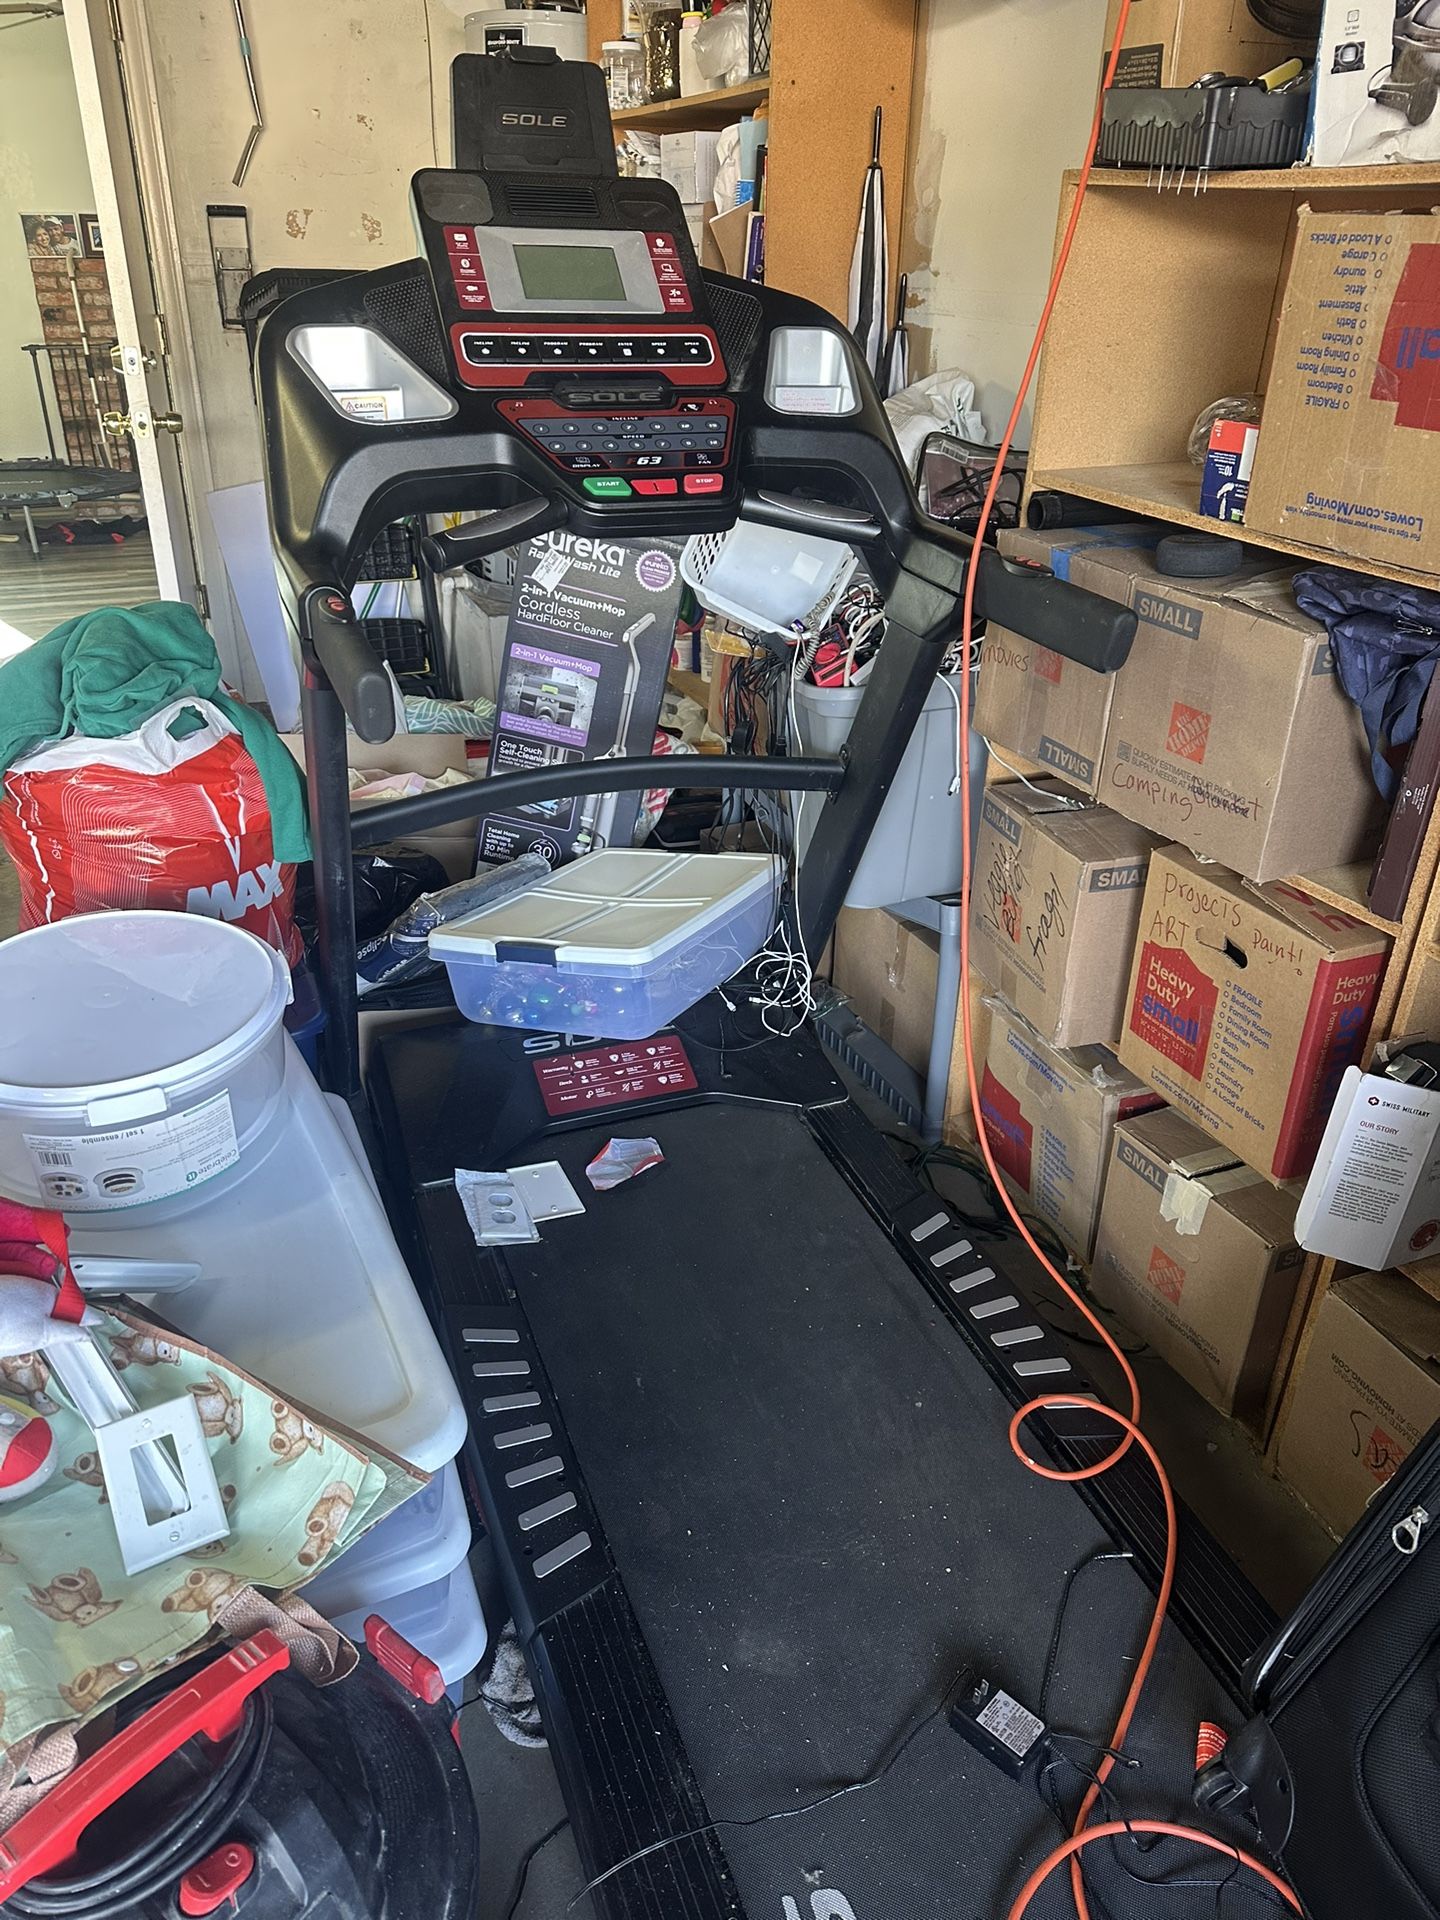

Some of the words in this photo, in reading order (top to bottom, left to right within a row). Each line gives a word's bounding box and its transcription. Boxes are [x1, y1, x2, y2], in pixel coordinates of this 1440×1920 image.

[502, 113, 568, 128] SOLE
[1310, 233, 1336, 244] Bricks
[1337, 233, 1348, 244] of
[1350, 233, 1375, 245] Load
[1376, 234, 1382, 245] A
[1333, 267, 1366, 278] aundry
[1344, 284, 1367, 295] Attic
[1319, 300, 1362, 312] Basement
[1336, 317, 1356, 329] Bath
[1322, 332, 1354, 345] Kitchen
[1300, 346, 1323, 359] Room
[1324, 348, 1350, 362] Dining
[1296, 361, 1318, 375] Room
[1319, 363, 1347, 378] Family
[1307, 379, 1344, 393] Bedroom
[568, 391, 661, 402] SOLE
[1305, 394, 1340, 409] FRAGILE
[626, 456, 662, 465] F63
[1306, 491, 1424, 532] Lowes.com/Moving
[1354, 519, 1368, 529] your
[1369, 523, 1388, 533] make
[1388, 527, 1396, 535] to
[1396, 529, 1409, 540] tips
[1410, 532, 1421, 542] For
[530, 530, 626, 567] eureka
[599, 564, 621, 579] Lite
[521, 582, 551, 598] 2-in-1
[553, 590, 626, 617] Vacuum+Mop
[518, 595, 581, 621] Cordless
[1138, 597, 1195, 634] SMALL
[518, 608, 572, 630] HardFloor
[573, 621, 614, 640] Cleaner
[515, 647, 538, 659] 2-in-1
[538, 652, 593, 673] Vacuum+Mop
[500, 740, 517, 749] One
[519, 743, 543, 755] Touch
[500, 747, 550, 765] Self-Cleaning
[1044, 744, 1091, 778] SMALL
[1131, 756, 1155, 773] SUPPLY
[1155, 768, 1178, 785] NEEDS
[1132, 747, 1160, 765] QUICKLY
[1160, 760, 1192, 780] ESTIMATE
[1213, 783, 1246, 805] PACKING
[1111, 762, 1193, 822] Camping
[986, 803, 1017, 840] SMALL
[486, 832, 511, 843] Cleaning
[488, 827, 502, 835] Total
[503, 830, 520, 839] Home
[484, 850, 515, 861] Runtime
[485, 843, 495, 851] 30
[497, 846, 510, 854] Min
[533, 845, 552, 859] 30
[1097, 868, 1140, 887] SMA
[1149, 910, 1190, 947] ART
[1150, 956, 1195, 996] Heavy
[1336, 972, 1380, 990] Heavy
[1146, 976, 1180, 1008] Duty
[1233, 983, 1264, 1009] FRAGILE
[1332, 988, 1367, 1006] Duty
[1231, 994, 1262, 1021] Bedroom
[1142, 994, 1199, 1045] small
[1228, 1006, 1252, 1025] Family
[1252, 1020, 1272, 1039] Room
[1327, 1011, 1338, 1032] Para
[1224, 1026, 1252, 1049] Kitchen
[1226, 1016, 1250, 1037] Dining
[1249, 1031, 1270, 1050] Room
[1323, 1033, 1332, 1048] uso
[1222, 1036, 1240, 1053] Bath
[1218, 1058, 1236, 1074] Attic
[1220, 1047, 1255, 1075] Basement
[1216, 1067, 1245, 1092] Laundry
[1214, 1077, 1241, 1100] Garage
[1149, 1070, 1221, 1130] Lowes.com/Moving
[1212, 1087, 1218, 1095] A
[1218, 1090, 1236, 1108] Load
[1235, 1104, 1244, 1116] of
[1243, 1109, 1266, 1131] Bricks
[1381, 1101, 1401, 1111] SWISS
[1402, 1106, 1432, 1118] MILITARY
[128, 1130, 139, 1138] set
[1359, 1120, 1375, 1130] OUR
[1376, 1124, 1400, 1136] STORY
[81, 1132, 119, 1144] ensemble
[1122, 1146, 1164, 1189] SMAL
[1331, 1352, 1396, 1416] HDMOVING.COM
